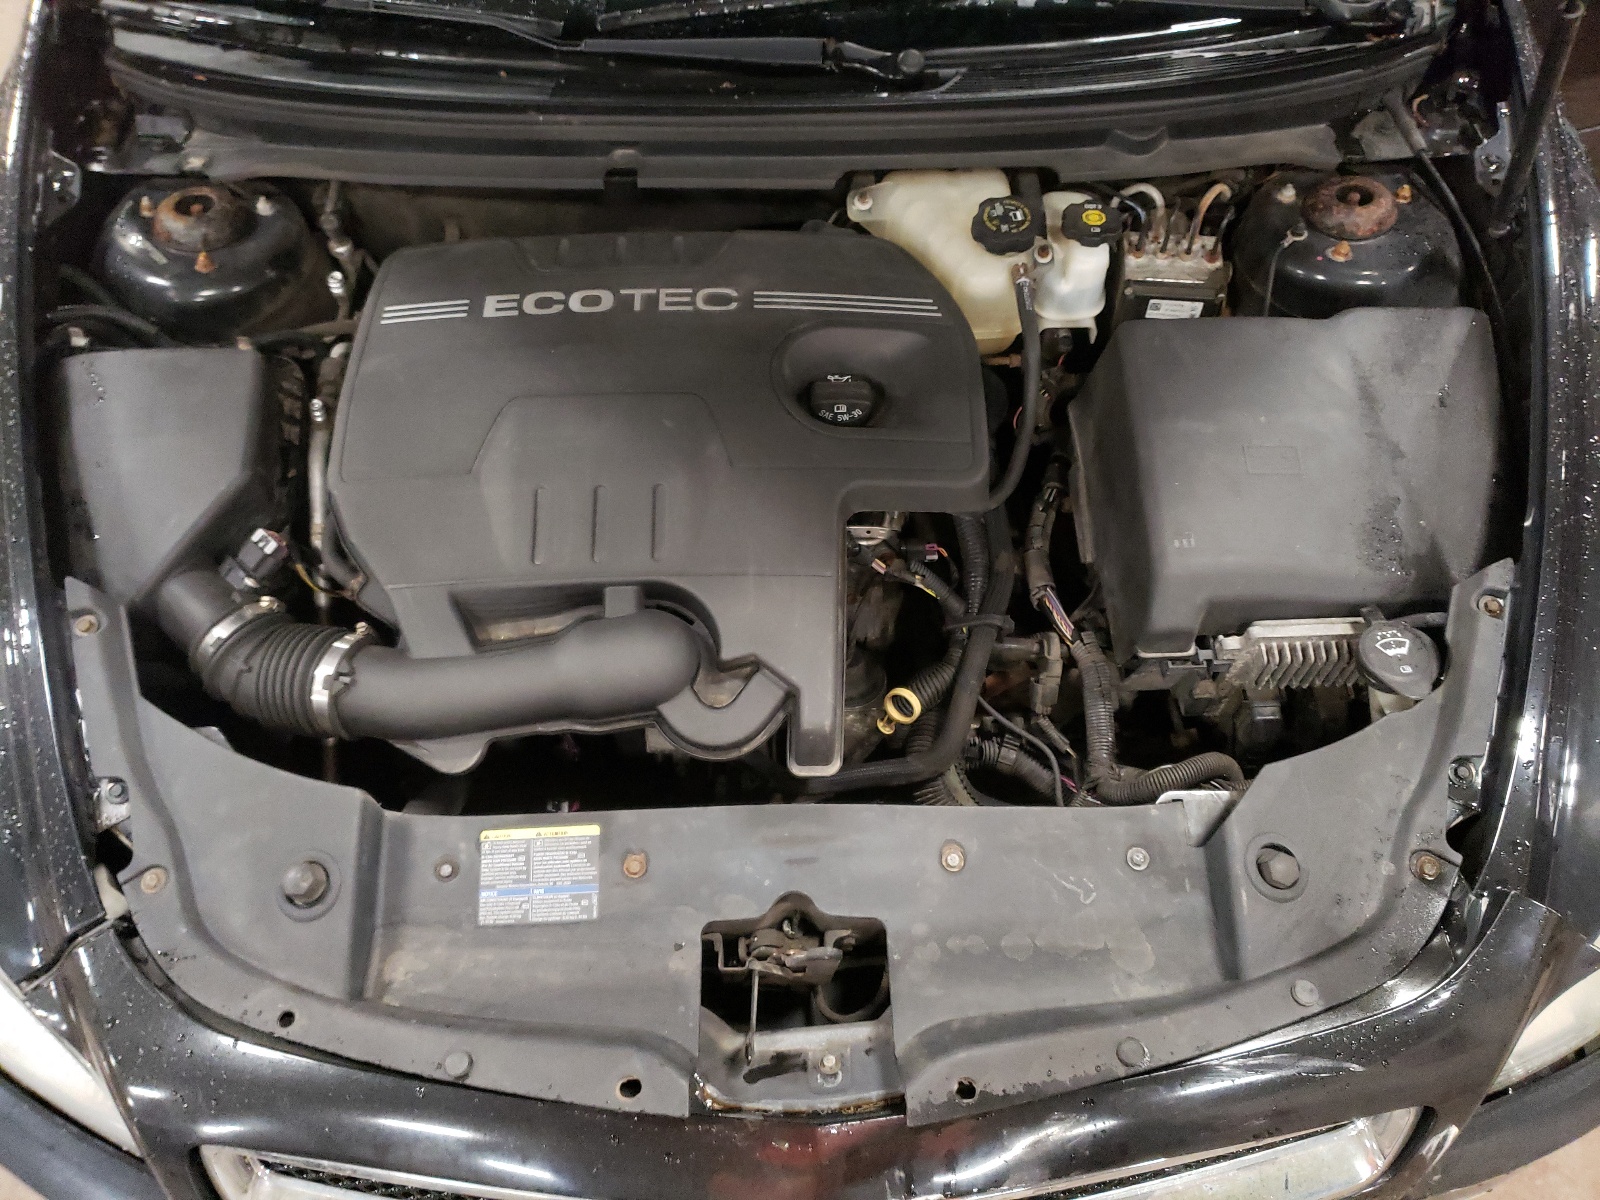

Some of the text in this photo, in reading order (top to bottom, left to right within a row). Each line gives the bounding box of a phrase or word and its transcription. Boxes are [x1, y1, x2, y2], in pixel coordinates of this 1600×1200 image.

[482, 287, 739, 318] ECOTEC
[818, 409, 862, 421] SAE 5W-30
